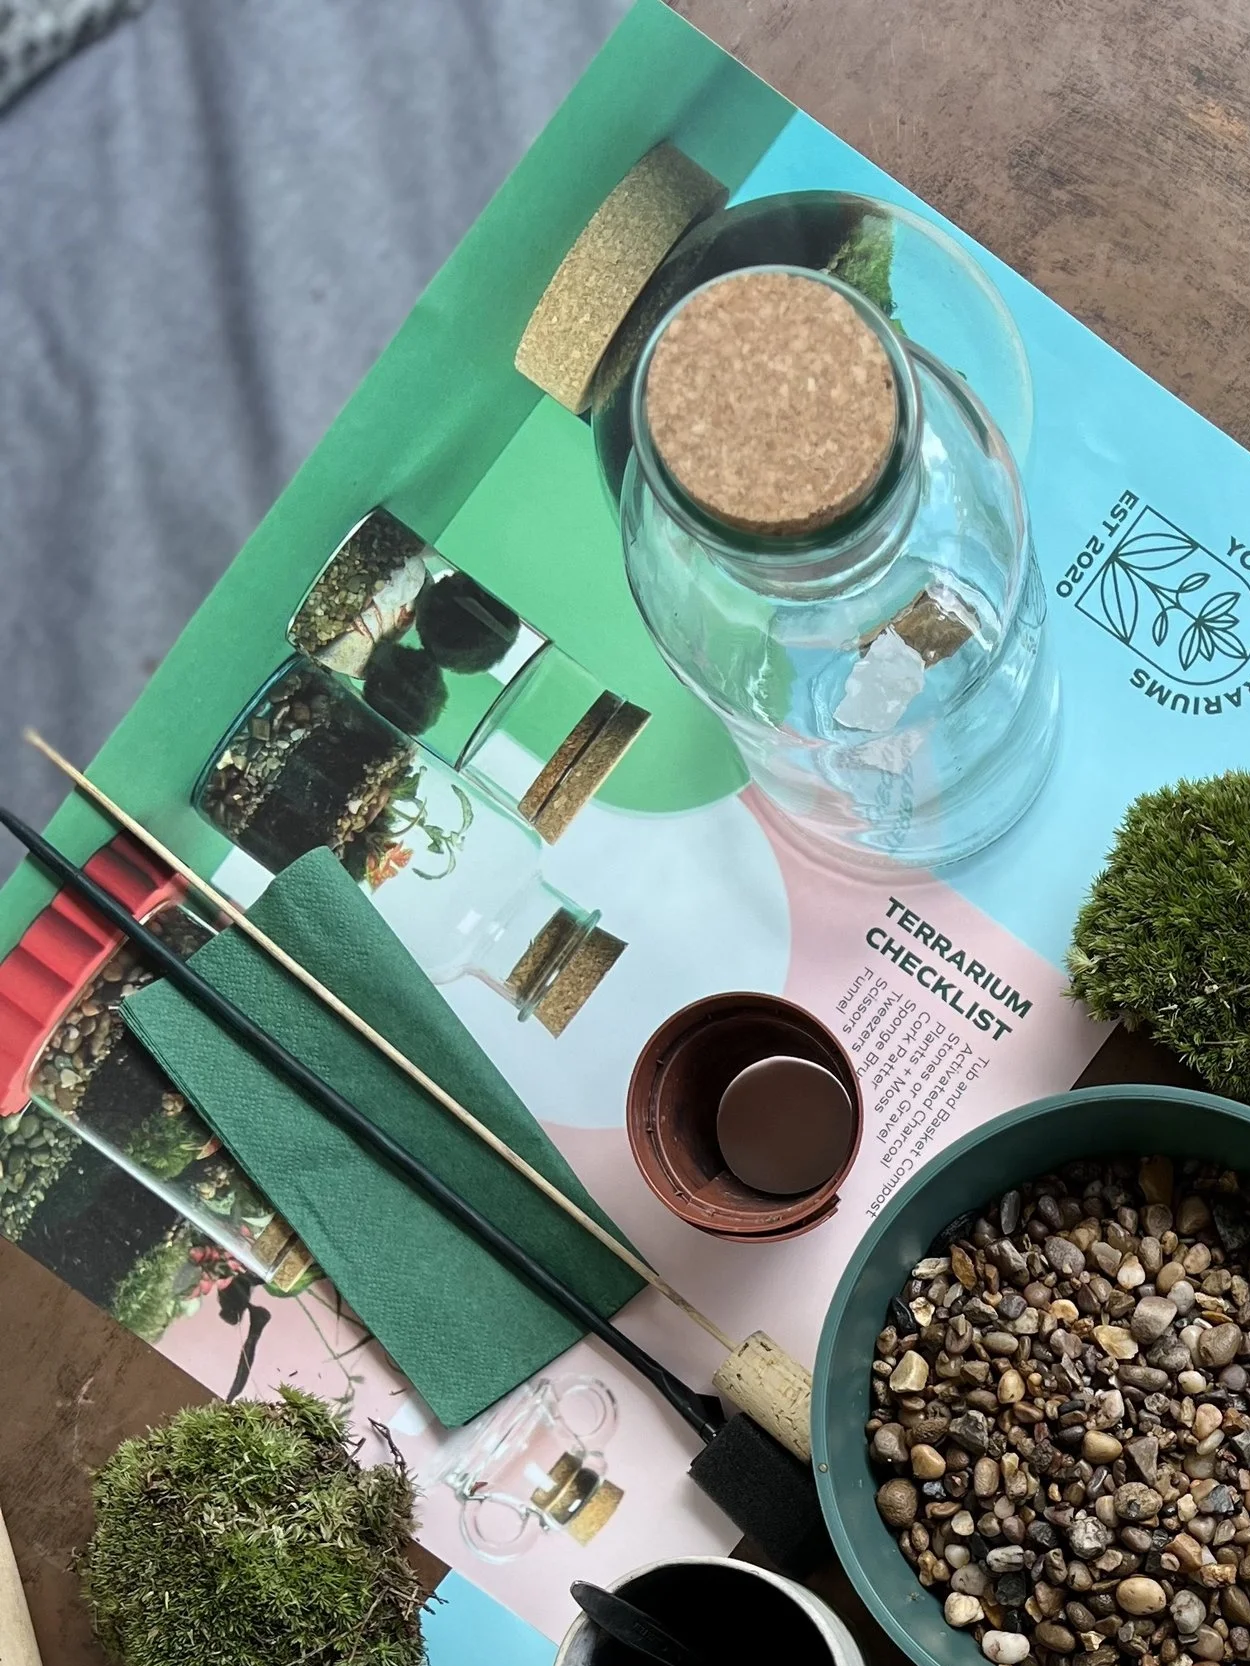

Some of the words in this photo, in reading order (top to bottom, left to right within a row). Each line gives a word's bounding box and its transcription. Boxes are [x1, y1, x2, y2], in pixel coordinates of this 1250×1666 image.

[1102, 489, 1140, 537] EST
[1056, 535, 1105, 599] 2020
[885, 896, 1034, 1019] TERRARIUM
[836, 966, 874, 1014] Funnel
[842, 977, 888, 1034] Scissors
[865, 927, 1013, 1042] CHECKLIST
[851, 991, 904, 1052] Tweezers
[875, 999, 917, 1050] Sponge
[902, 1012, 931, 1044] Cork
[910, 1021, 946, 1065] Plants
[855, 1052, 879, 1078] Bru
[870, 1044, 908, 1090] Patter
[920, 1032, 960, 1081] Stones
[922, 1042, 973, 1111] Activated
[965, 1057, 990, 1081] Tub
[874, 1076, 906, 1114] Moss
[910, 1082, 922, 1099] or
[945, 1081, 968, 1110] and
[876, 1099, 911, 1144] Gravel
[880, 1110, 926, 1169] Charcoal
[910, 1109, 951, 1157] Basket
[865, 1158, 914, 1218] Compost
